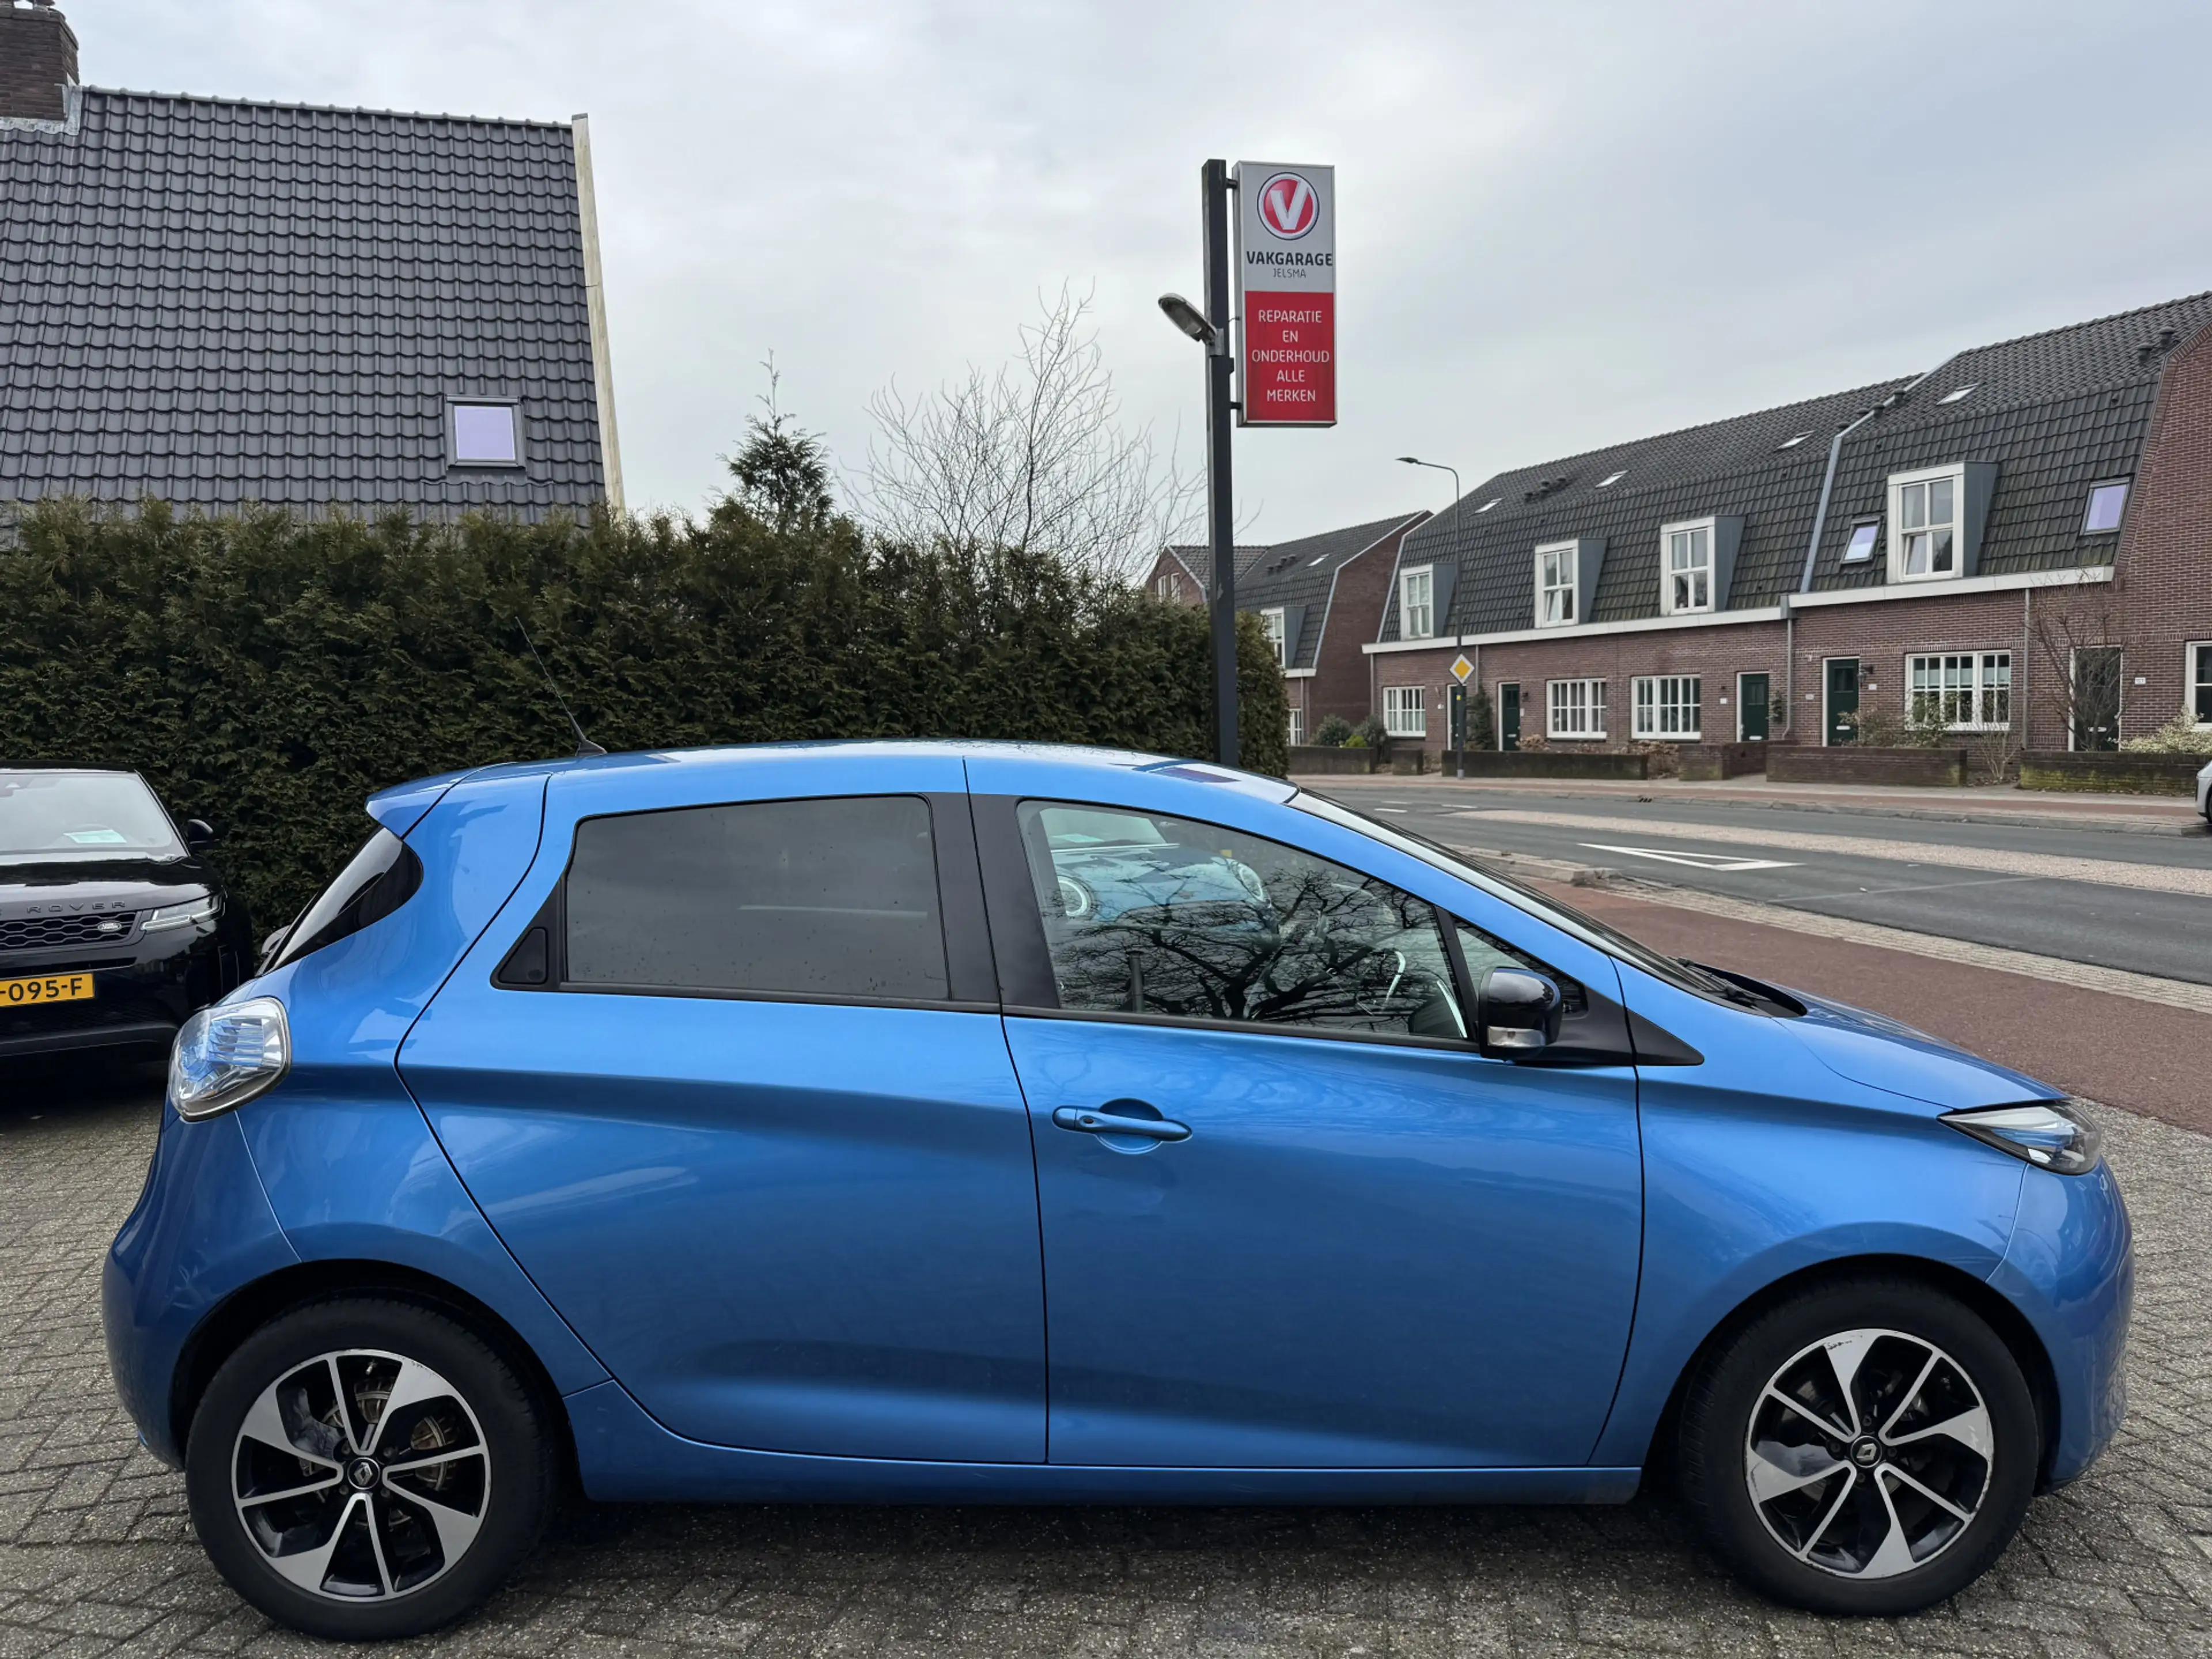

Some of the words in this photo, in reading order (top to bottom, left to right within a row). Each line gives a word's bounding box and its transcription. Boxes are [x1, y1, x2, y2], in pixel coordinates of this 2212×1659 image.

[1270, 180, 1309, 230] V
[1247, 251, 1332, 266] VAKGARAGE
[1272, 268, 1306, 278] JELSMA
[1258, 309, 1323, 323] REPARATIE
[1282, 329, 1298, 343] EN
[1252, 349, 1330, 363] ONDERHOUD
[1277, 369, 1305, 382] ALLE
[1267, 389, 1316, 402] MERKEN
[26, 900, 126, 914] ROVER
